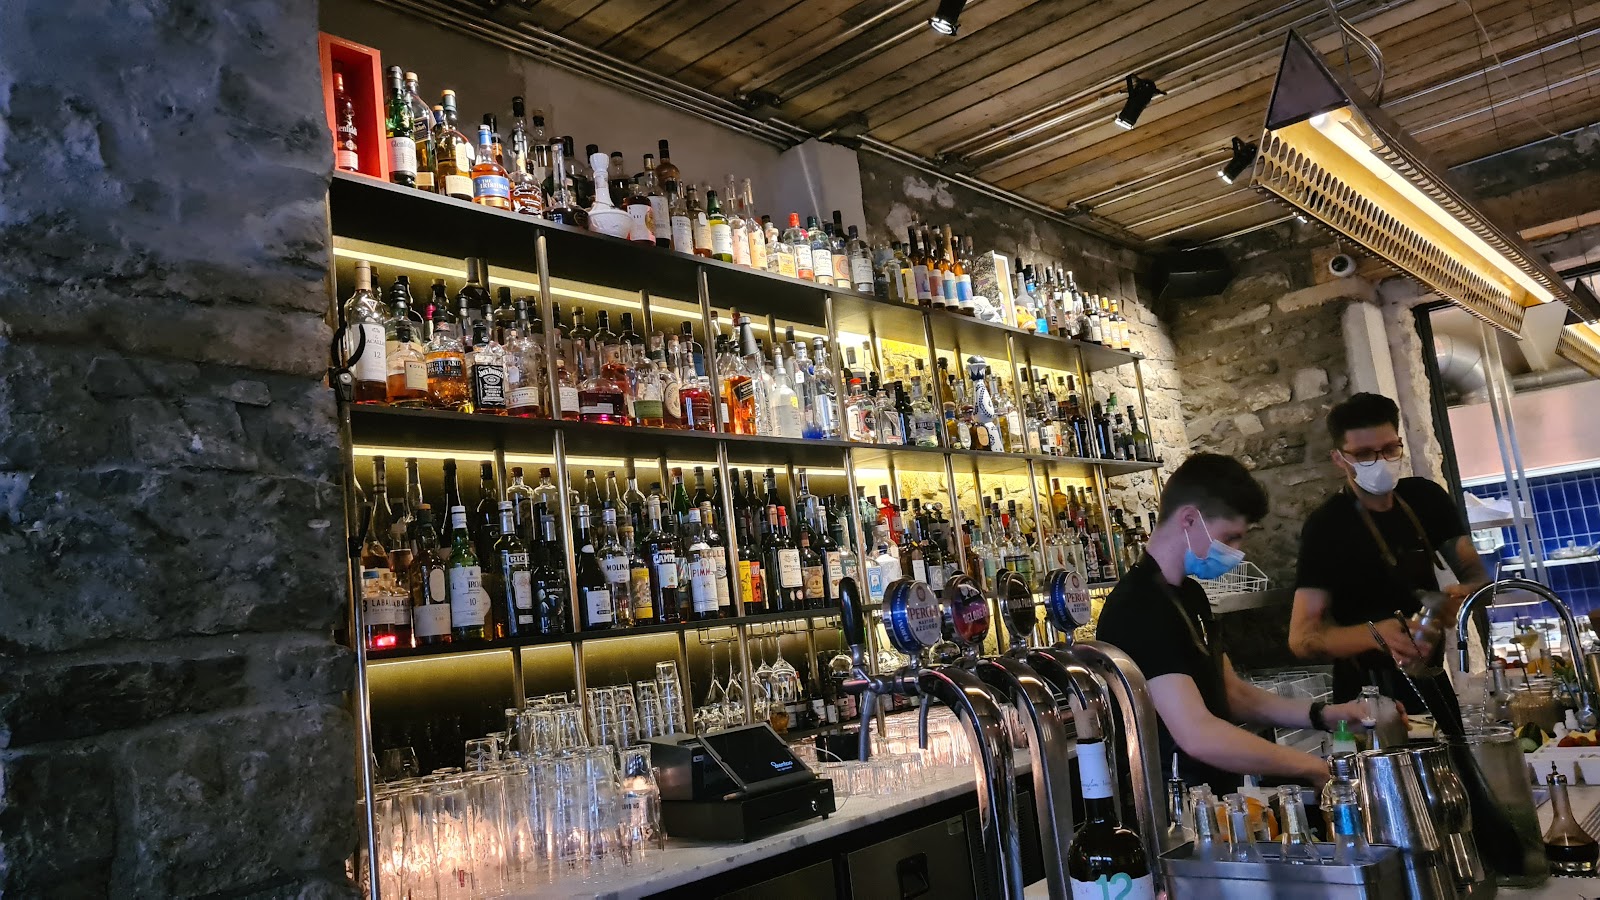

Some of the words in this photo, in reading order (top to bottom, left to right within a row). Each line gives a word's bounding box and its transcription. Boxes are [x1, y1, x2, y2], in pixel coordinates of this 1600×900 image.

[469, 598, 477, 606] 10
[908, 605, 939, 620] PERONI
[1095, 872, 1133, 900] 12
